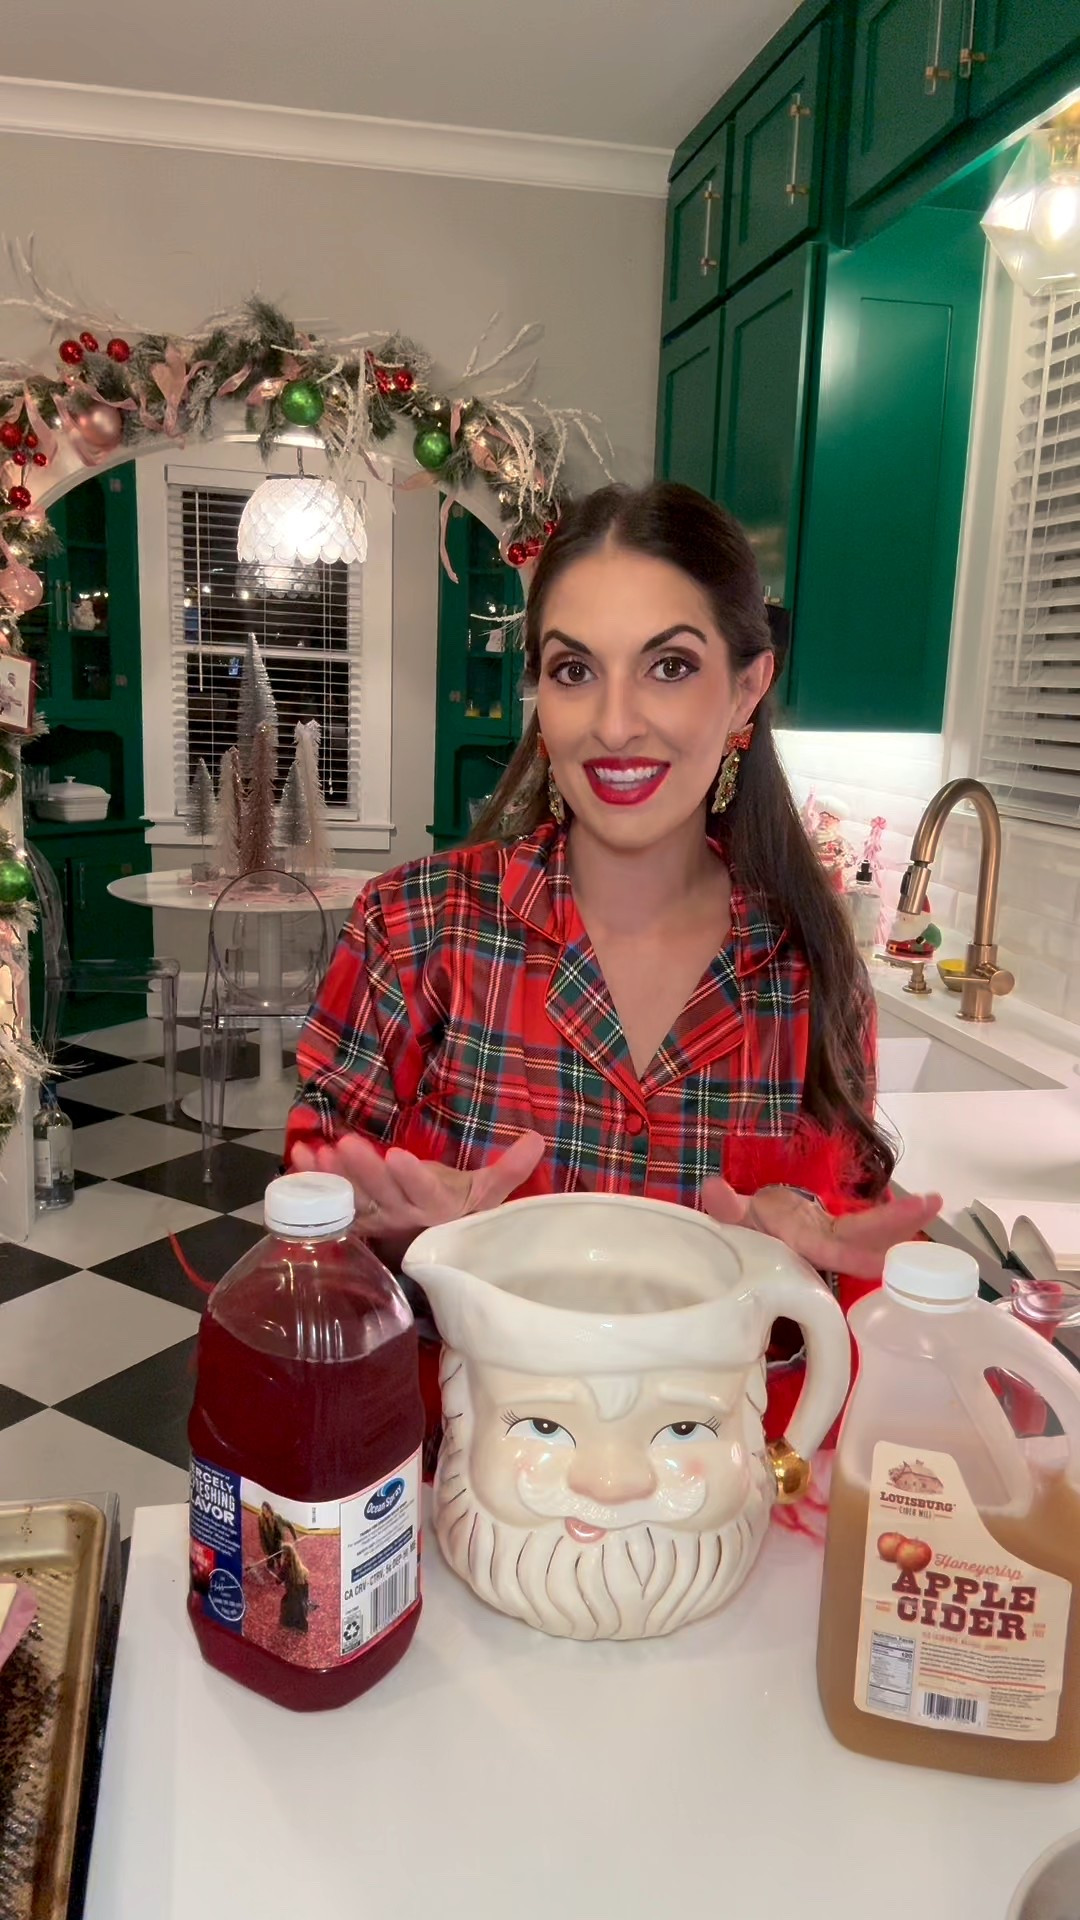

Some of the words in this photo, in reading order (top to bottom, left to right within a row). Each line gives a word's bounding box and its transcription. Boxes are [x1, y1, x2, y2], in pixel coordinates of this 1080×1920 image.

[366, 1502, 386, 1514] Ocean
[385, 1484, 402, 1508] Spray
[880, 1491, 953, 1513] LOUISBURG
[934, 1553, 1024, 1581] Honeycrisp
[344, 1589, 354, 1601] CA
[891, 1567, 1037, 1613] APPLE
[897, 1595, 1027, 1641] CIDER
